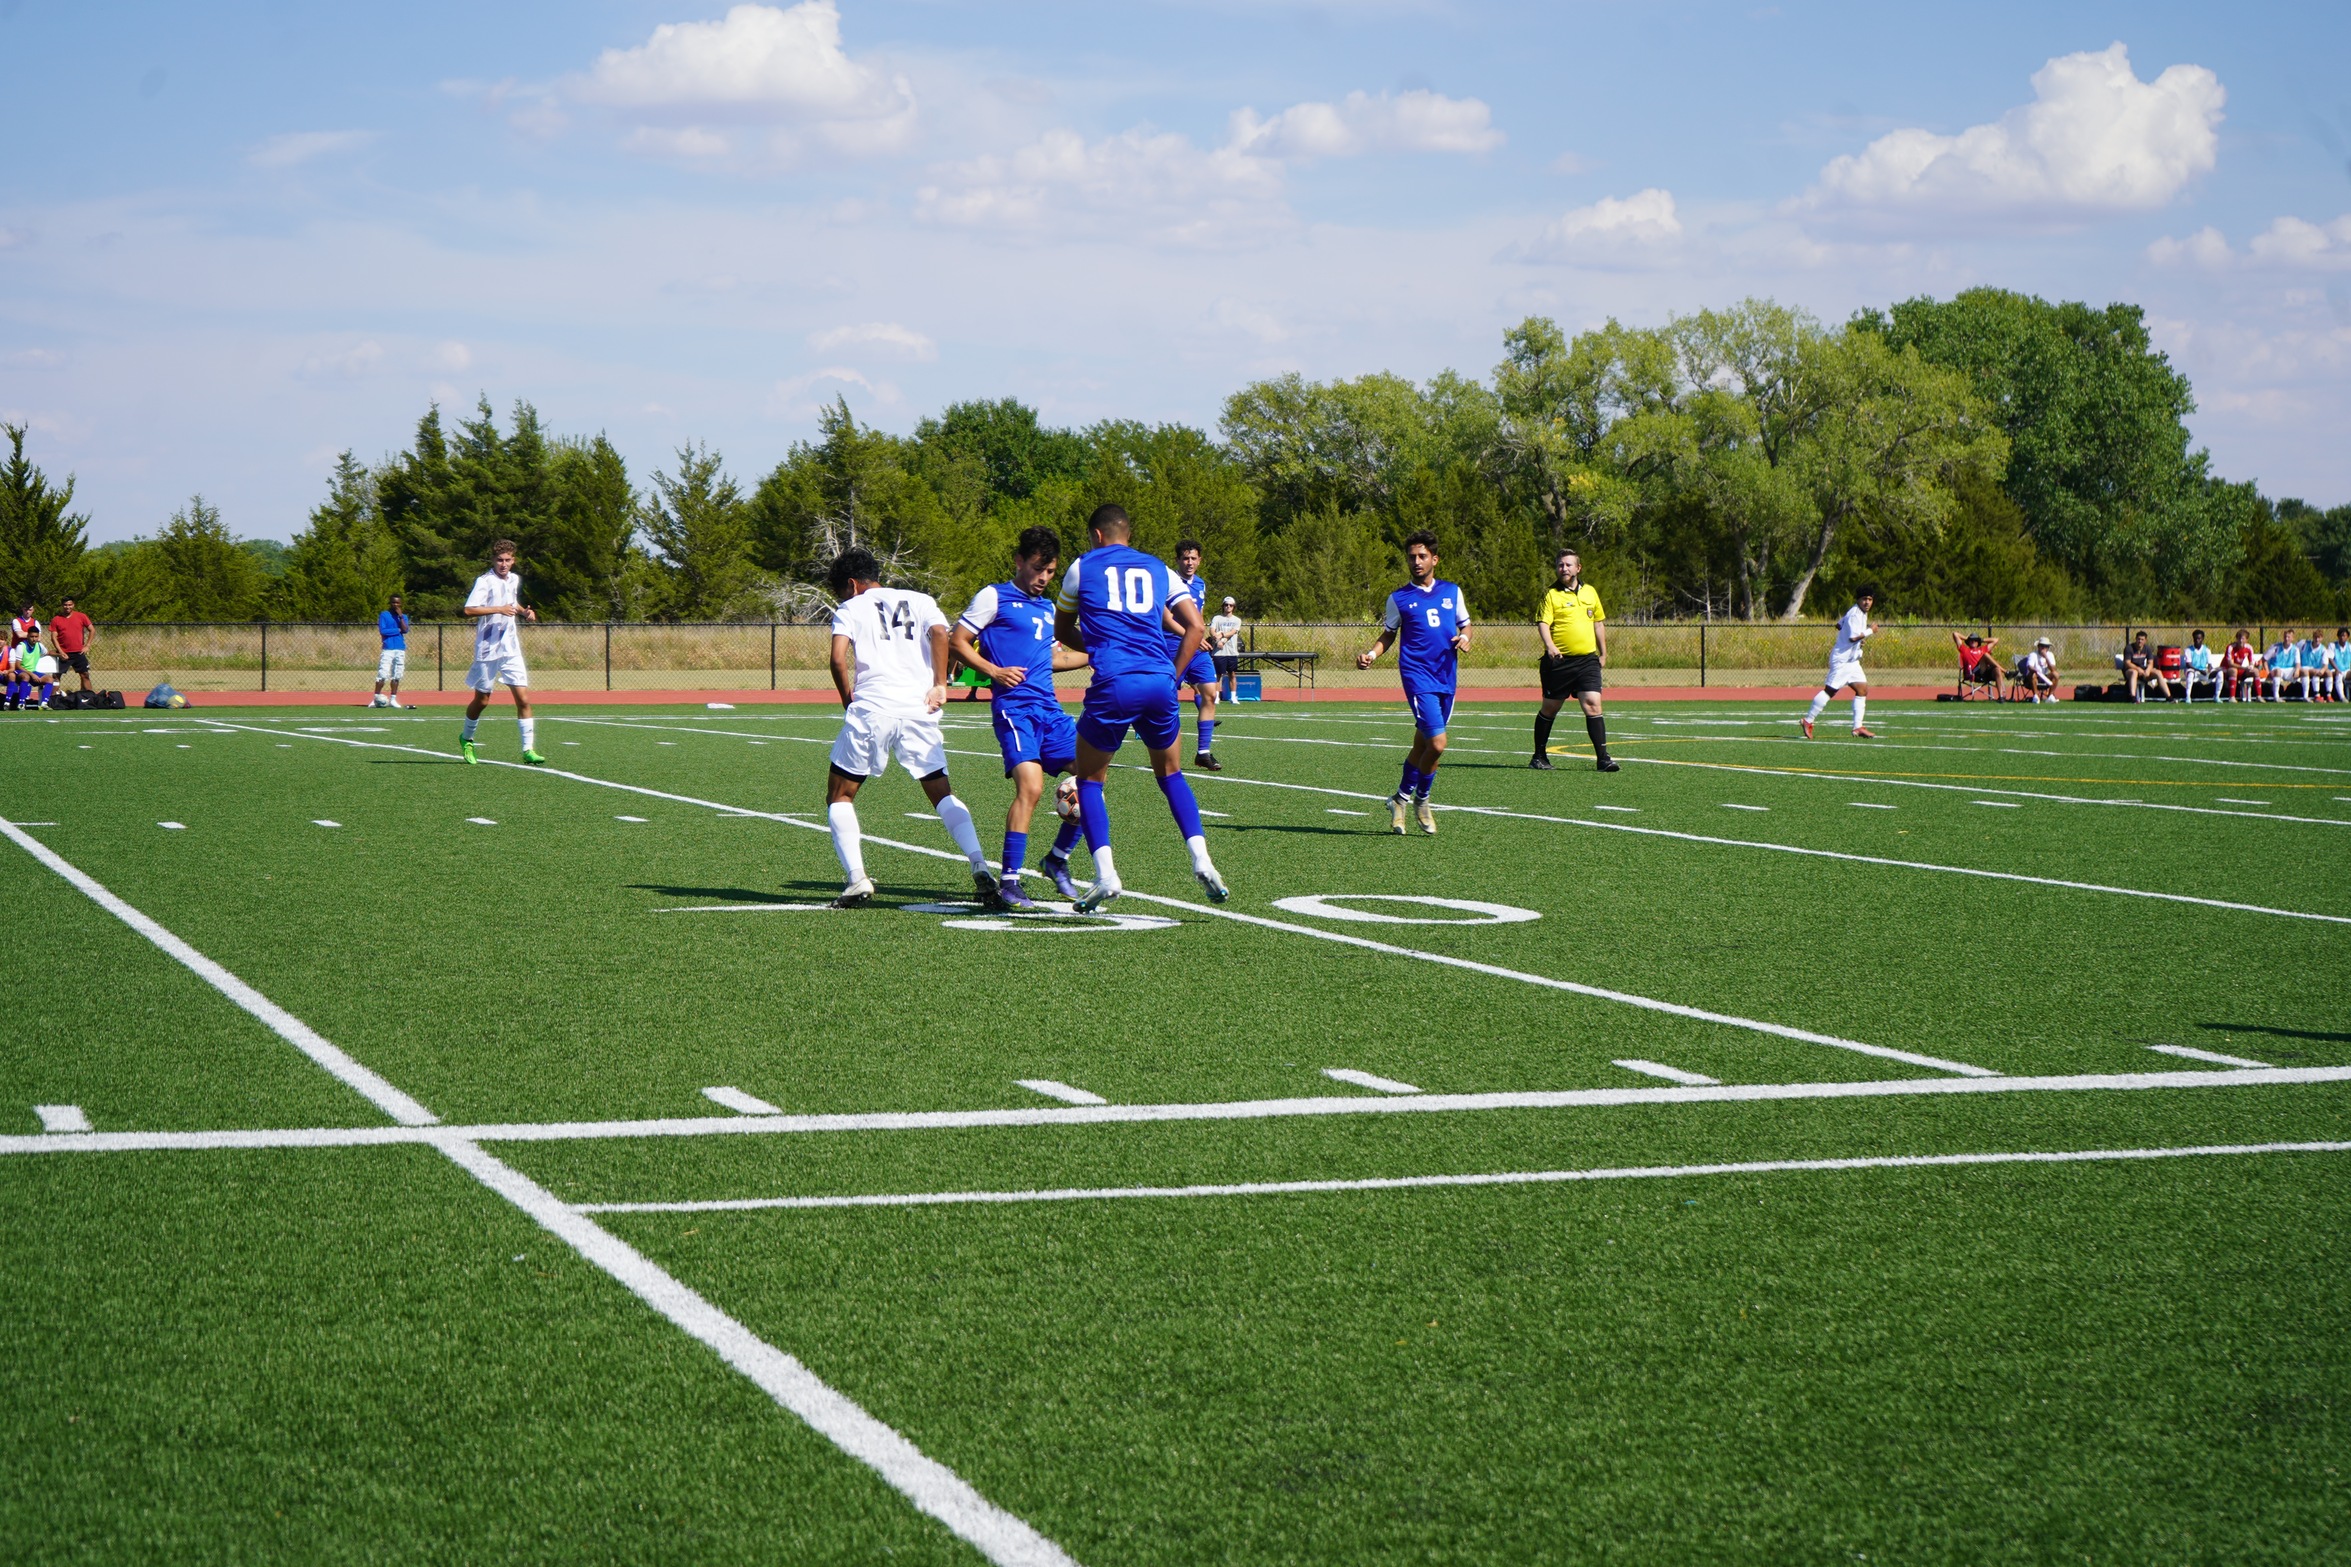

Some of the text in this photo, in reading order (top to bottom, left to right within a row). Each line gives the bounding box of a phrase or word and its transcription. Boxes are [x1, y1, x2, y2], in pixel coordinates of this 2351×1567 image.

[1104, 566, 1154, 614] 10
[874, 600, 915, 641] 14
[1031, 616, 1044, 641] 7
[1426, 608, 1441, 628] 6
